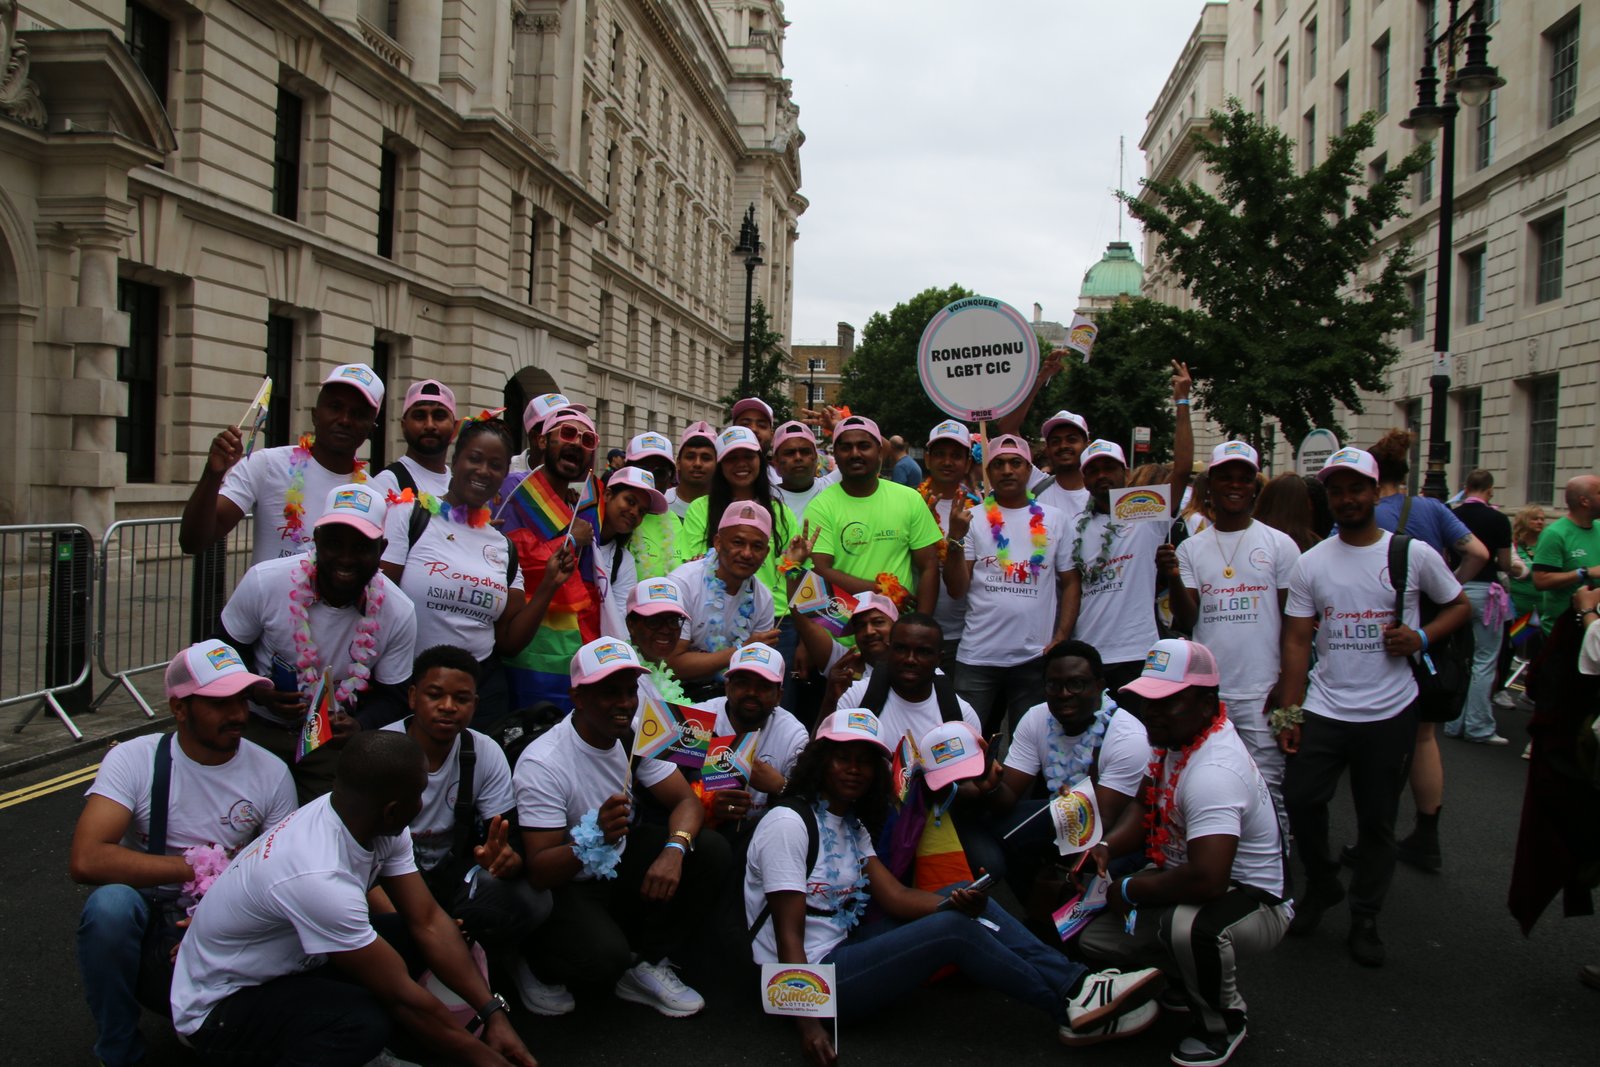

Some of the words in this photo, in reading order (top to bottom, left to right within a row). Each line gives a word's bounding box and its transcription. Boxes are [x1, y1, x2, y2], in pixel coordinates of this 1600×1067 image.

[948, 299, 998, 313] VOLUNQUEER
[931, 341, 1024, 362] RONGDHONU
[947, 363, 982, 378] LGBT
[986, 361, 1011, 375] CIC
[1115, 501, 1166, 519] Rainbow
[985, 585, 1039, 596] COMMUNITY
[1201, 583, 1269, 597] Rongdhanu
[427, 587, 455, 601] ASIAN
[457, 587, 503, 612] LGBT
[1219, 596, 1260, 611] LGBT
[1203, 613, 1259, 623] COMMUNITY
[768, 984, 830, 1008] Rainbow
